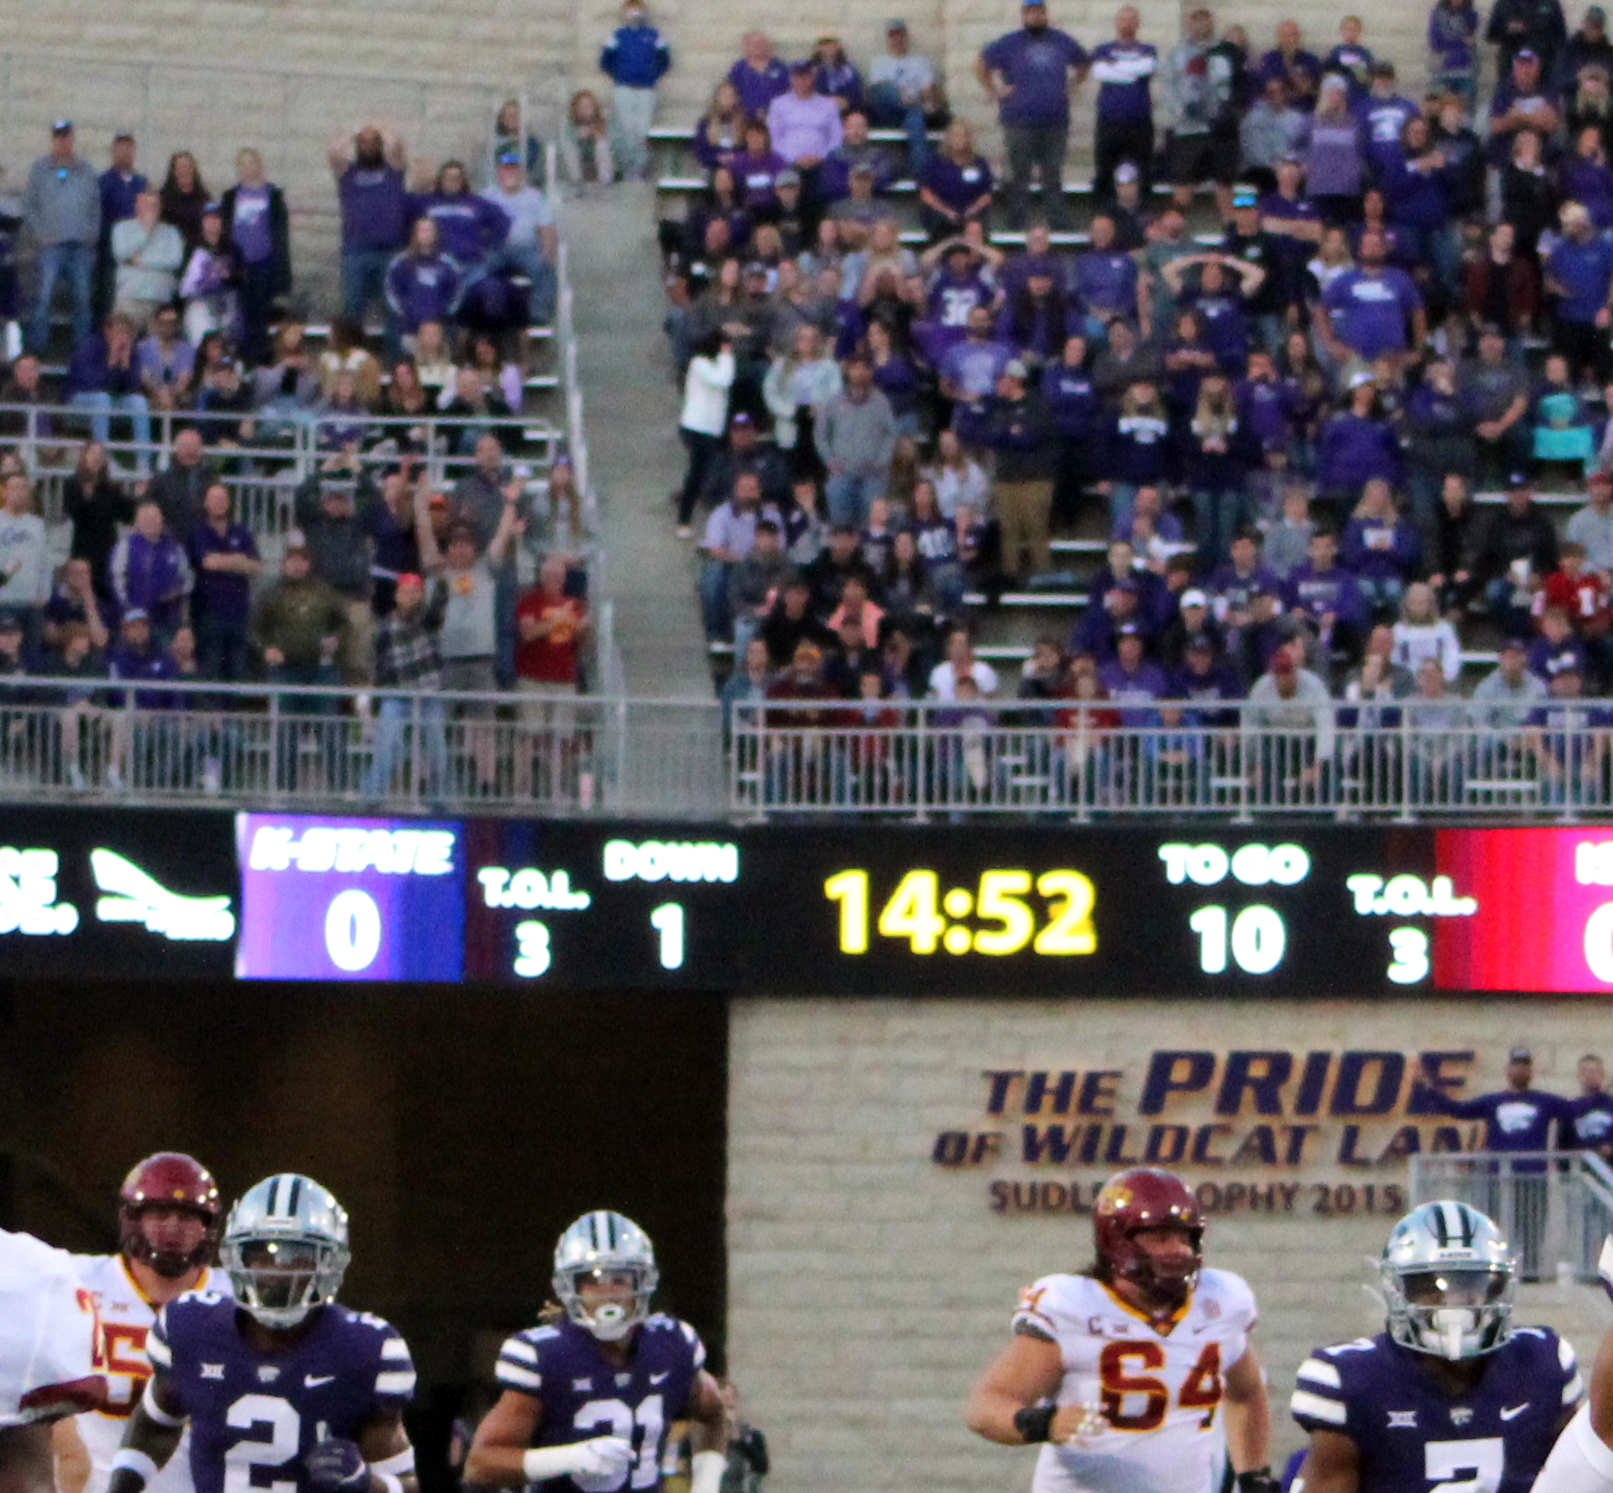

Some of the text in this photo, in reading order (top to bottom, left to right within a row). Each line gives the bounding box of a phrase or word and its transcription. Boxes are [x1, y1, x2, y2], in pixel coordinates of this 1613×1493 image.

[248, 829, 456, 885] K-STATE
[603, 840, 738, 883] DOWN
[1158, 843, 1310, 885] TO GO
[324, 886, 382, 973] 0
[650, 903, 684, 969] 1
[824, 869, 1097, 957] 14:52
[1189, 904, 1286, 974] 10
[513, 920, 551, 977] 3
[1387, 927, 1429, 984] 3
[981, 1049, 1477, 1121] THE PRIDE
[930, 1124, 1483, 1168] OF WILDCAT LAN
[989, 1178, 1099, 1216] SUDL
[1099, 1340, 1226, 1433] 64
[571, 1395, 664, 1493] 31
